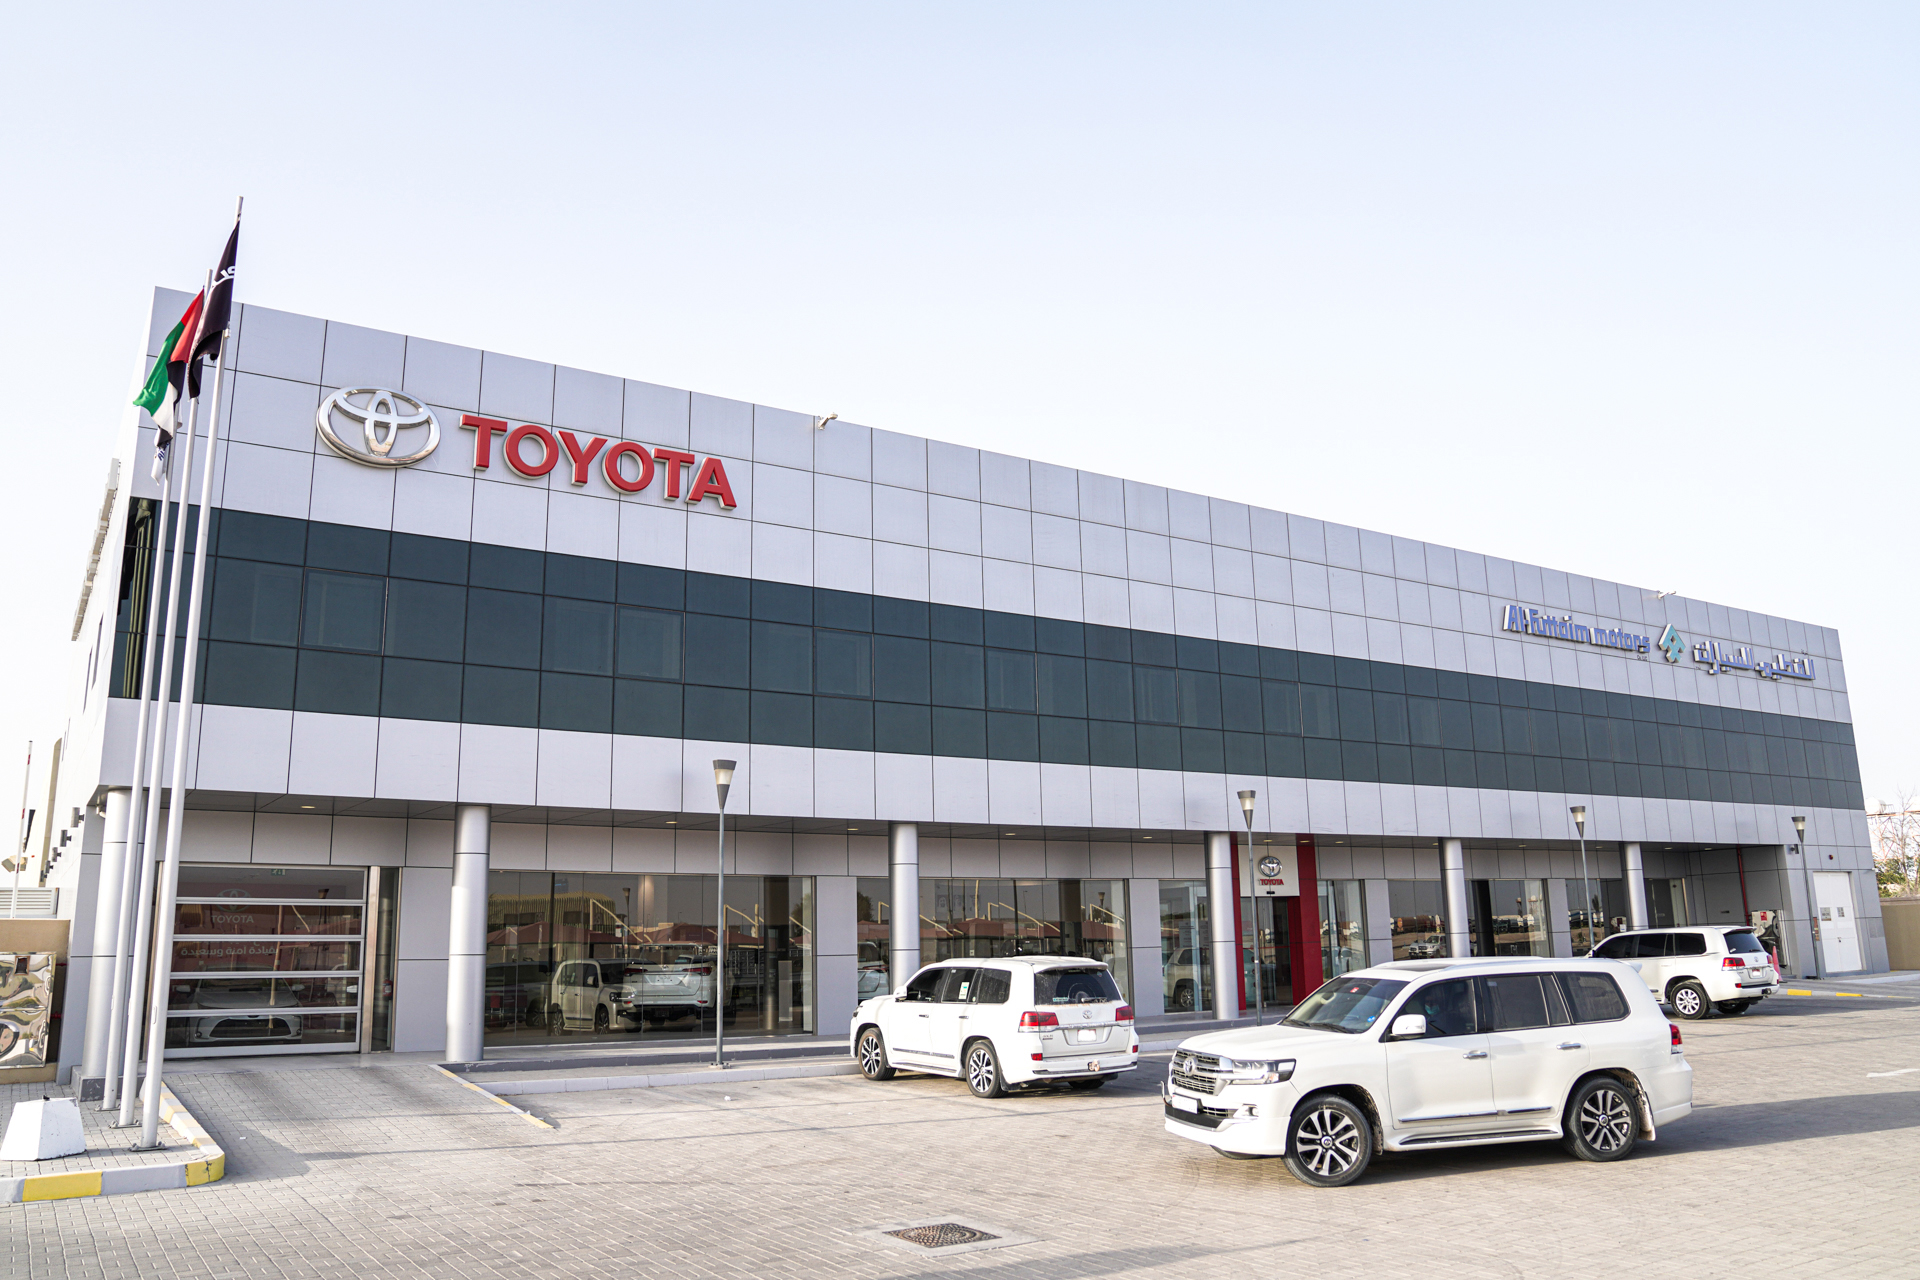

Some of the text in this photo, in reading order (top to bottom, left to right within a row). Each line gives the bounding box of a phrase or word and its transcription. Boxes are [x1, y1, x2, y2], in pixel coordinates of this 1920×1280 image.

[459, 413, 738, 511] TOYOTA
[1590, 627, 1651, 654] motors
[1259, 878, 1285, 886] TOYOTA
[212, 914, 254, 924] TOYOTA
